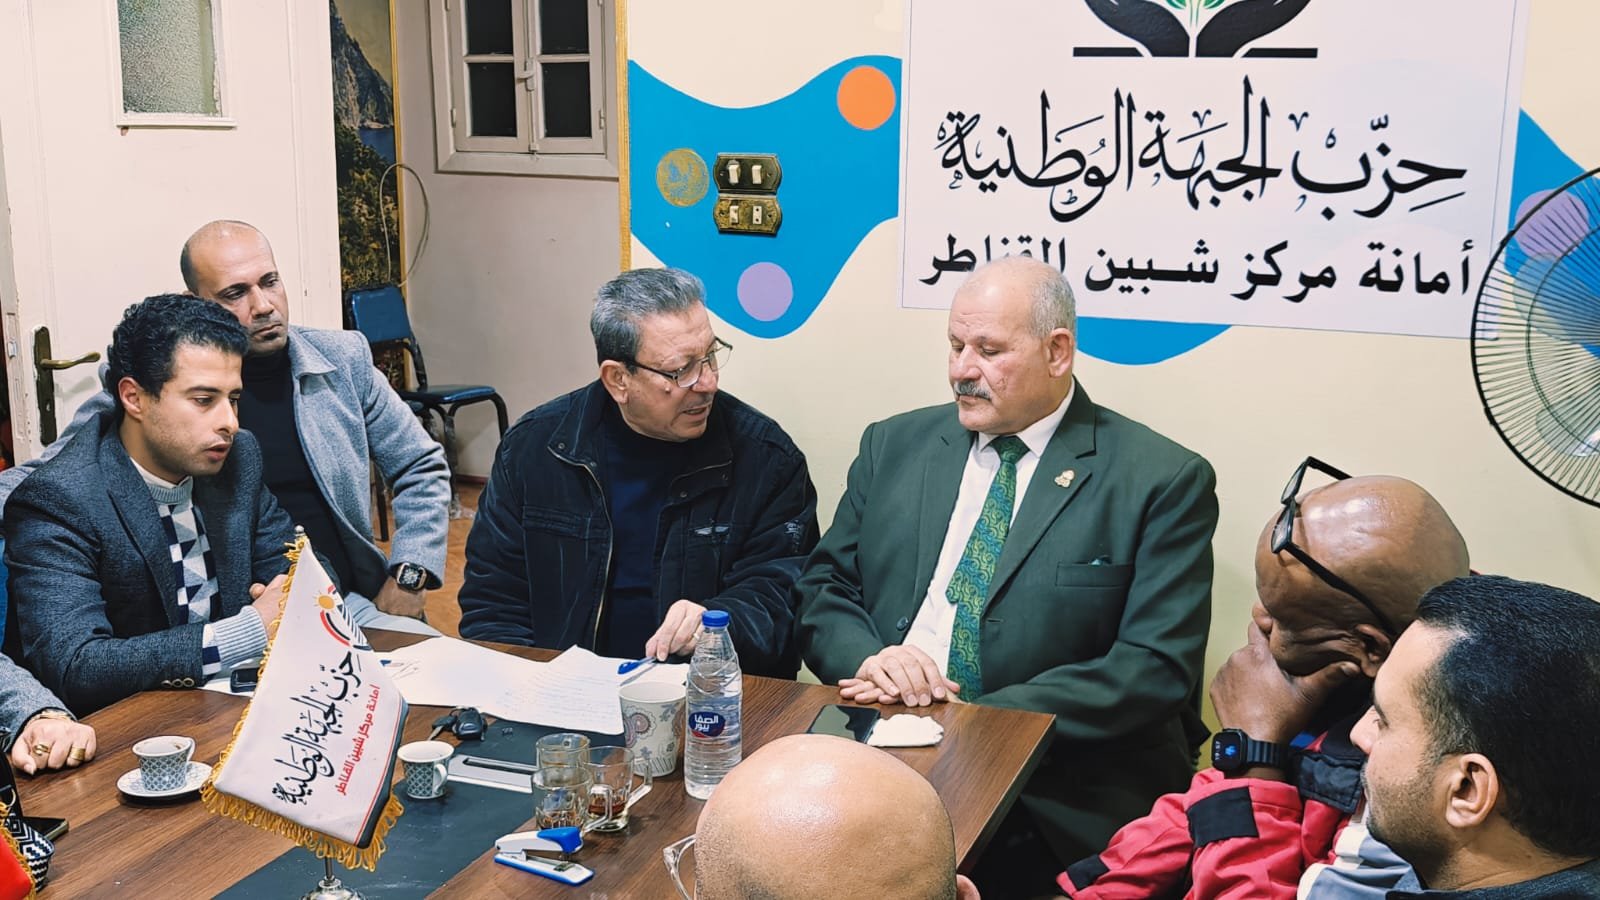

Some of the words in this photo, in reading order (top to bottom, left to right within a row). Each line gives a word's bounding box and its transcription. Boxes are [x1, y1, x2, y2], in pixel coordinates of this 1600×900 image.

[1085, 239, 1219, 295] شبين
[1230, 240, 1337, 304] مركز
[1359, 239, 1474, 295] أمانة
[358, 712, 374, 738] مركز
[694, 713, 719, 724] الصفا
[347, 736, 365, 762] شبين
[335, 760, 356, 796] القناطر
